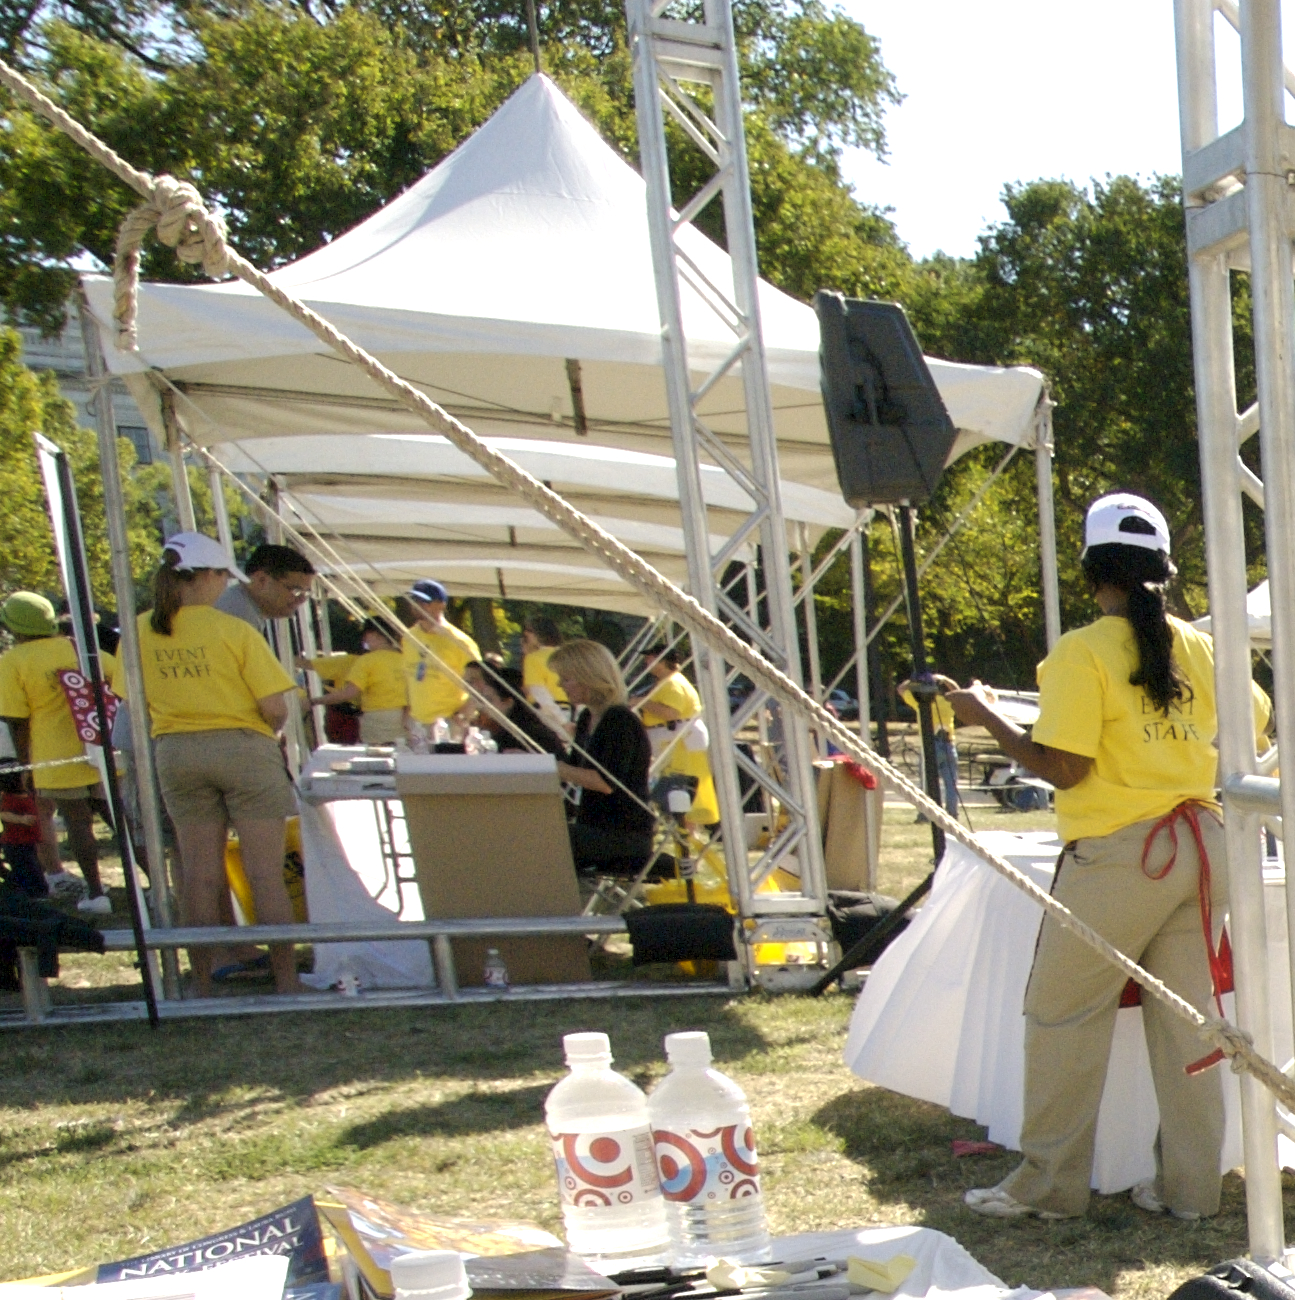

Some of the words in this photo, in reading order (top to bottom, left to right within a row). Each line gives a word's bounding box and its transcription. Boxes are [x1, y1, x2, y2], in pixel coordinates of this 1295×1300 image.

[155, 646, 207, 662] EVENT
[160, 664, 211, 680] STAFF
[118, 1216, 301, 1281] NATIONAL
[191, 1231, 239, 1250] CONGRESS
